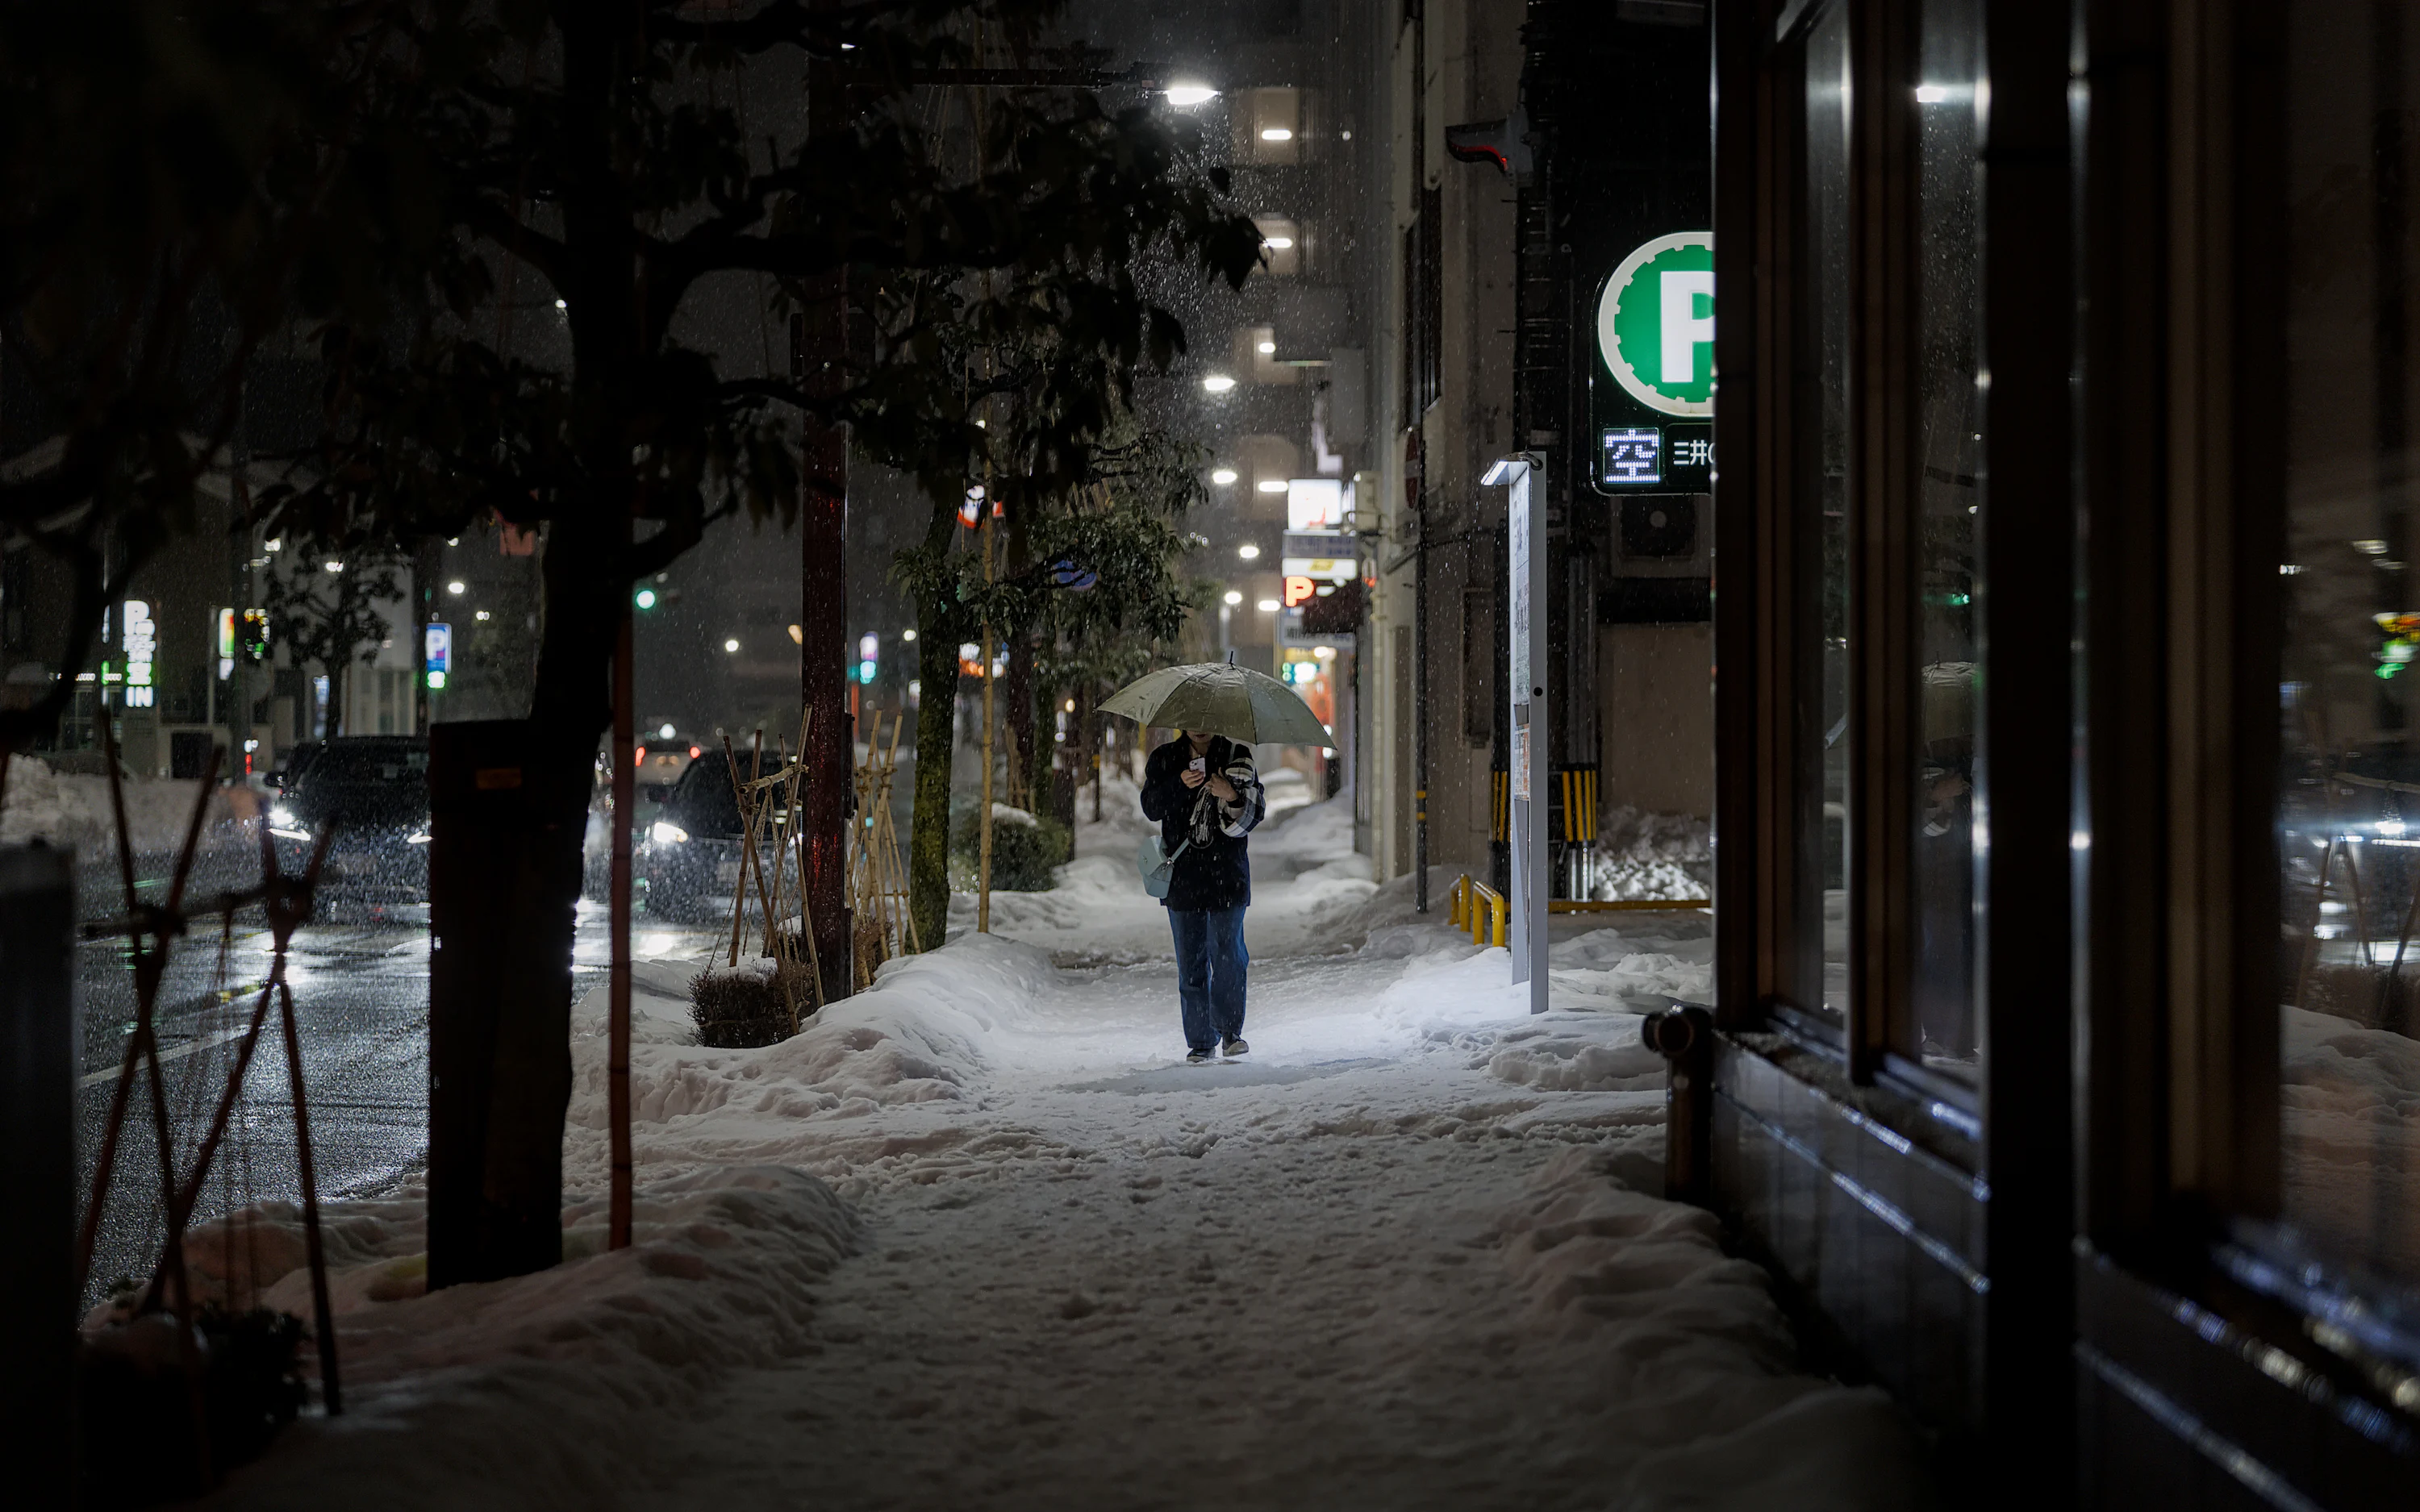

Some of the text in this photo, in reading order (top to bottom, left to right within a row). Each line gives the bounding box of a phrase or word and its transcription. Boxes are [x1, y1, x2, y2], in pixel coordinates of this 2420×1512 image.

[1661, 271, 1715, 382] P
[1605, 429, 1659, 482] 空
[1285, 576, 1315, 606] P
[426, 629, 446, 660] P
[126, 686, 153, 707] IN
